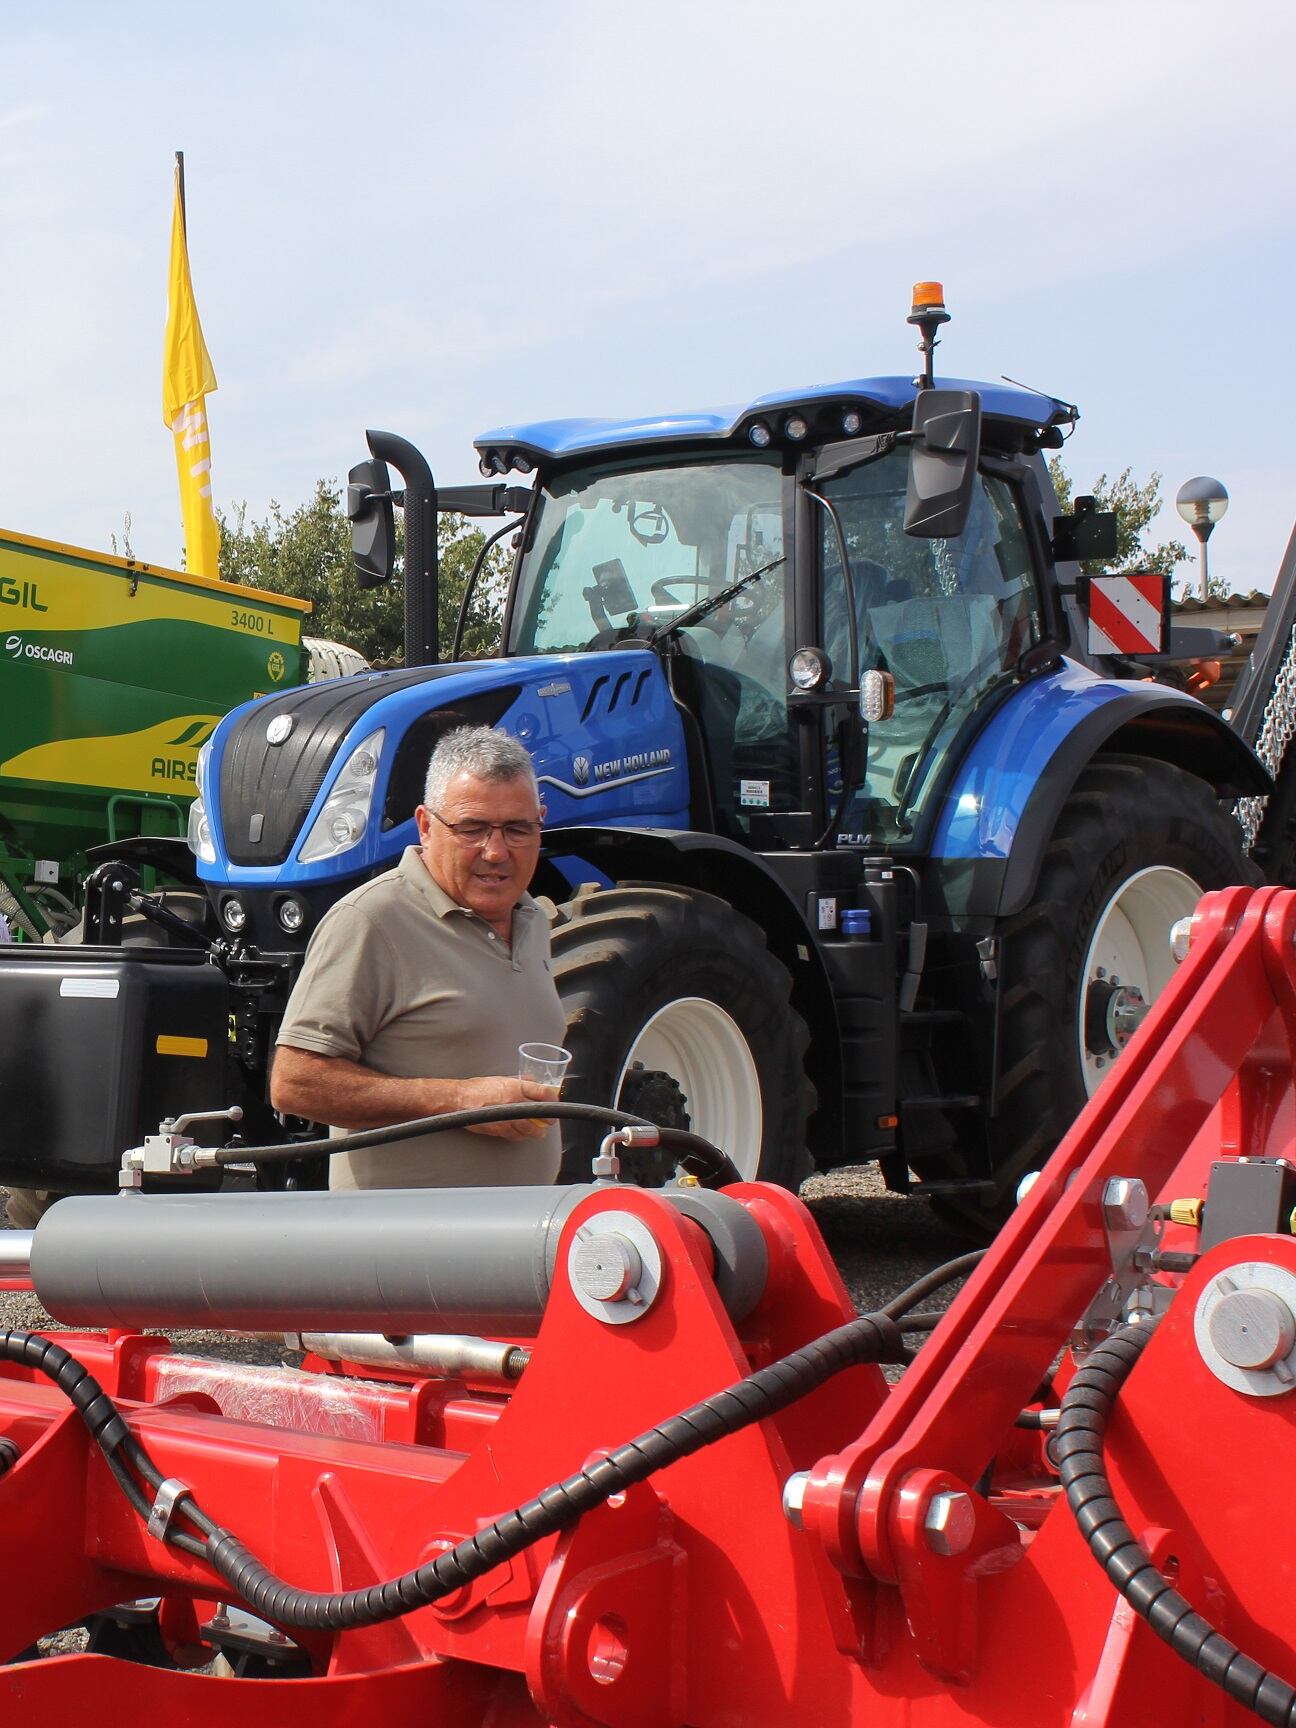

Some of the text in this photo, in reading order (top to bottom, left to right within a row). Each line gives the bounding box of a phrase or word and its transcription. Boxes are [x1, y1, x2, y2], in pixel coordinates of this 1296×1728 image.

[231, 610, 274, 635] 3400 L
[25, 644, 73, 665] OSCAGRI
[594, 749, 671, 782] NEW HOLLAND
[836, 833, 872, 845] PLM
